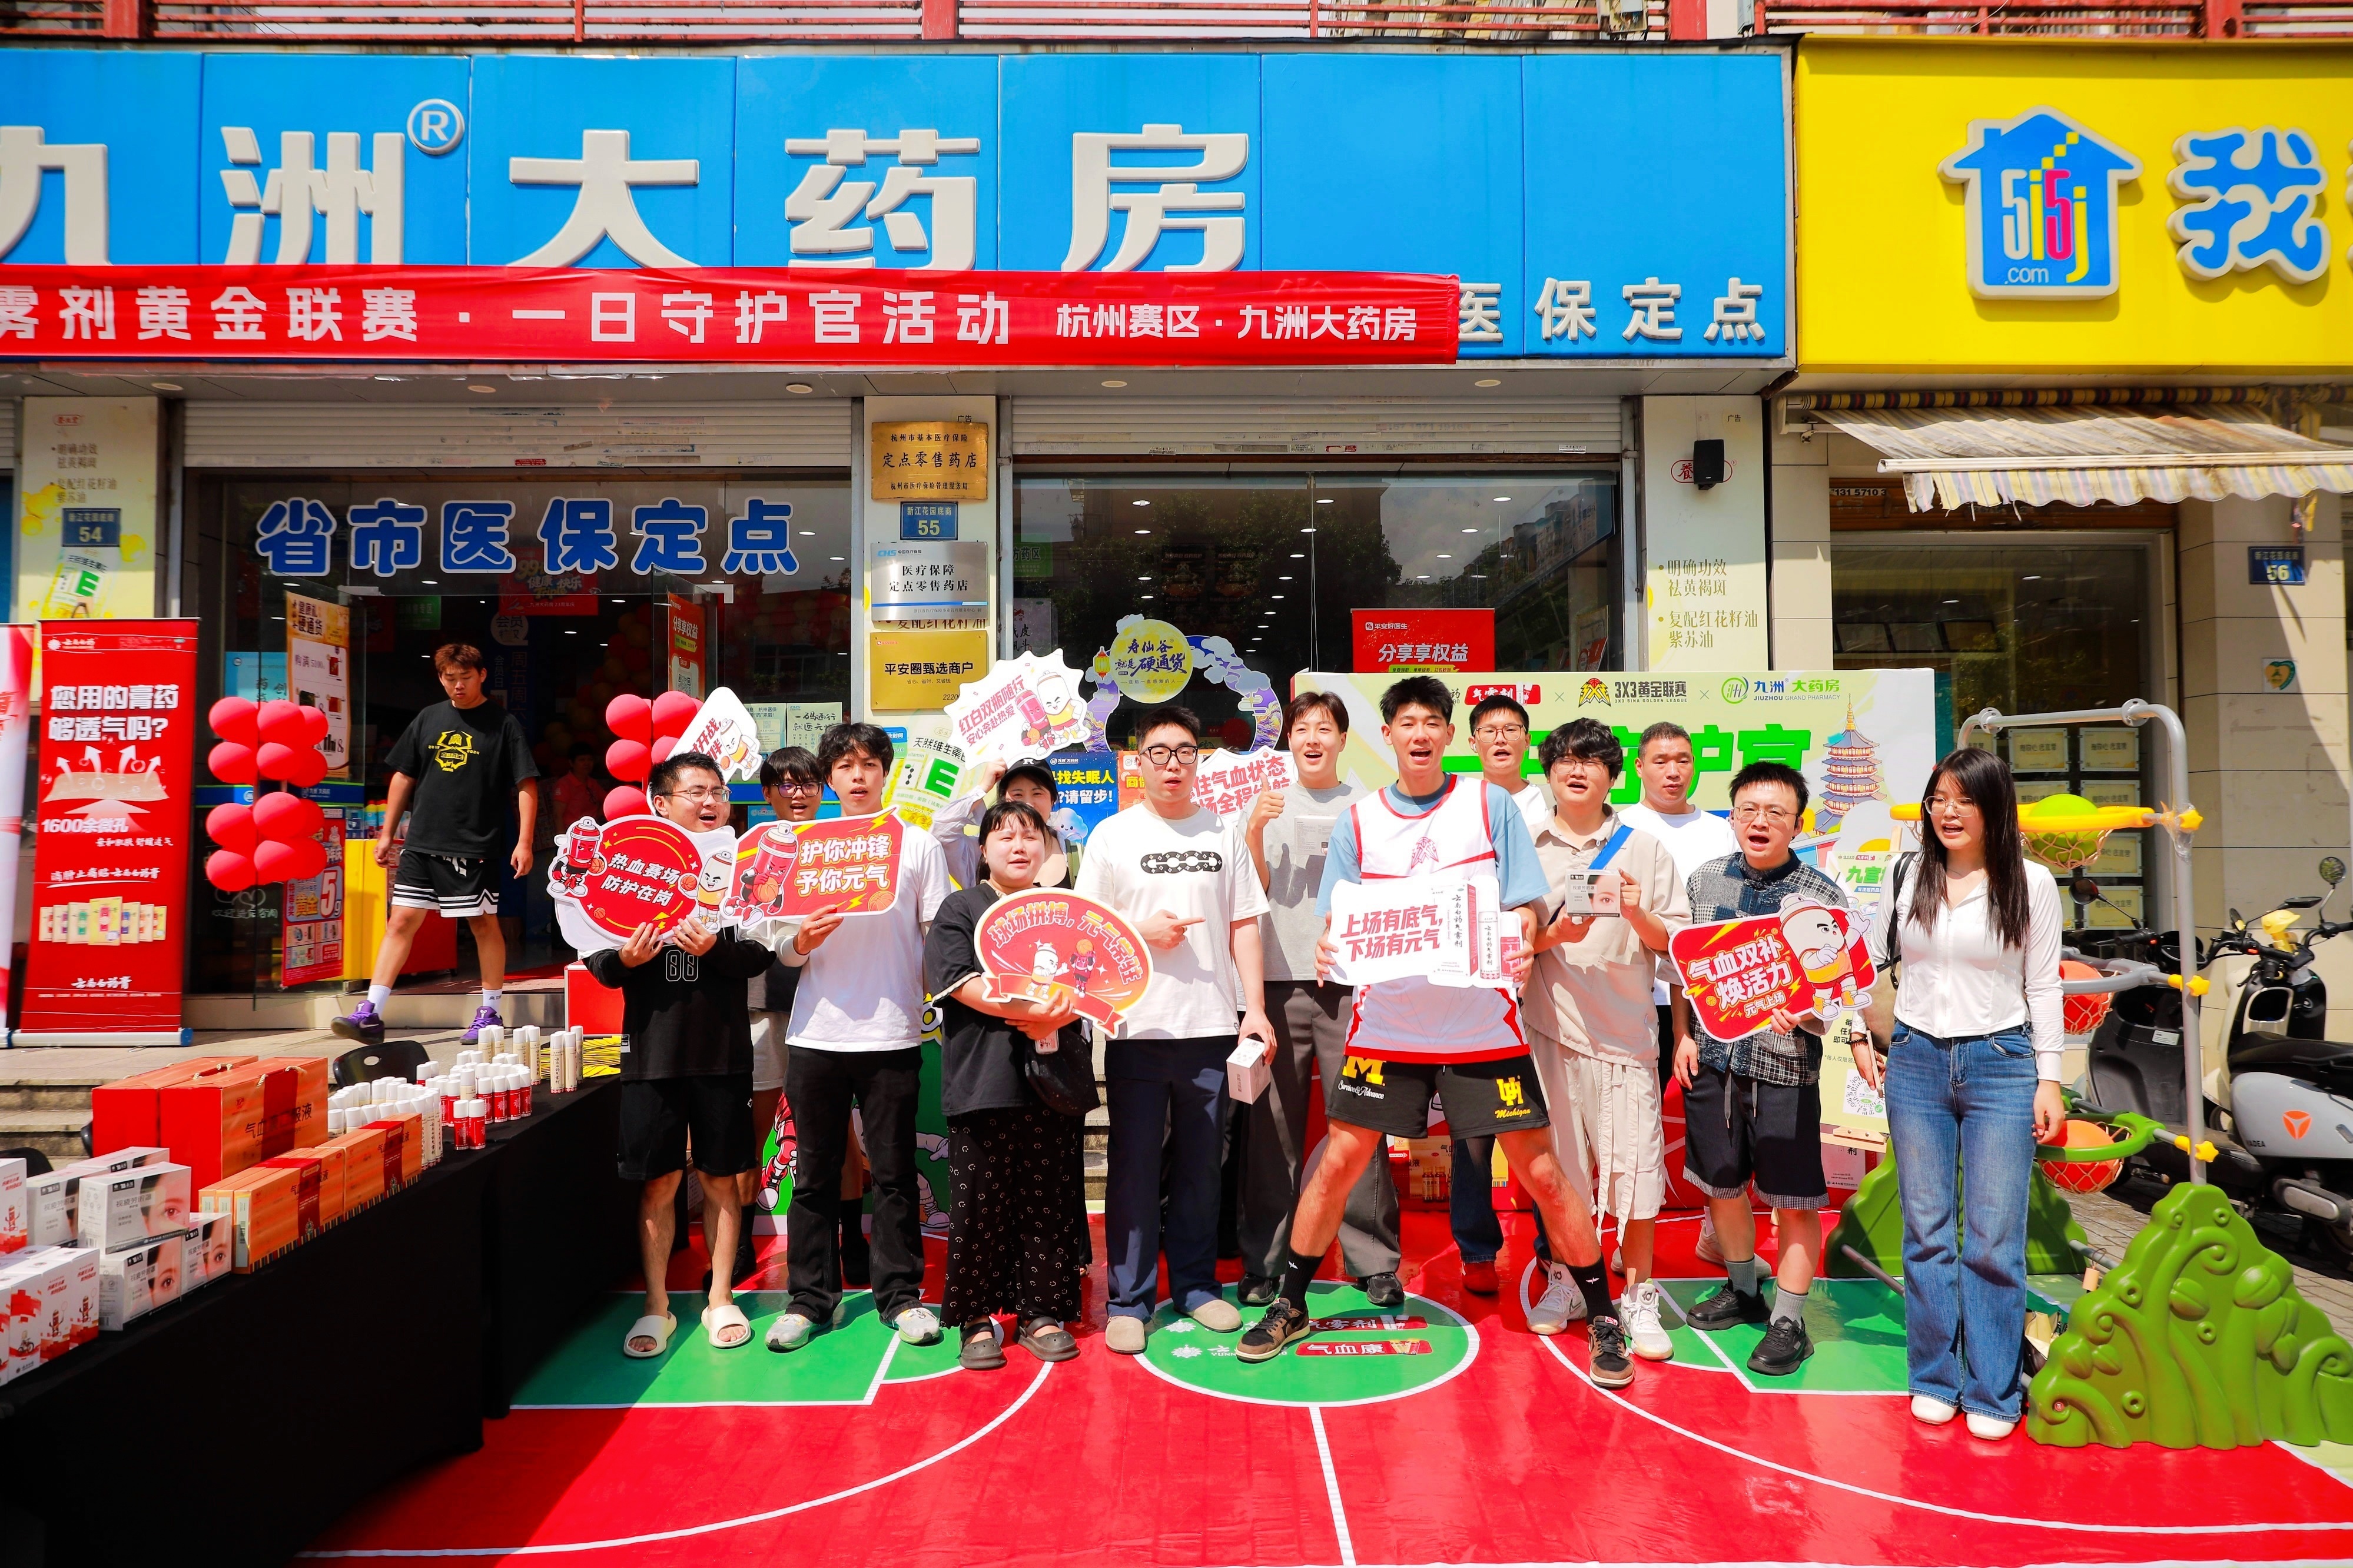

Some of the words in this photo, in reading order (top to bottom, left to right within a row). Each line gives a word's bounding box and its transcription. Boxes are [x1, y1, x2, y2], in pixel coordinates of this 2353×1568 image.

[2002, 168, 2088, 283] 5i5j
[2005, 266, 2049, 285] .com
[1458, 276, 1766, 343] 医保定点
[1056, 303, 1418, 343] 杭州赛区·九洲大药房
[957, 414, 972, 423] 广告
[1727, 414, 1741, 422] 广告
[890, 433, 968, 443] 杭州市基本医疗保险
[882, 451, 978, 469] 定点零售药店
[890, 481, 968, 491] 杭州市医疗保险管理服务局
[907, 506, 953, 516] 新江花园底商
[79, 526, 103, 543] 54
[255, 496, 800, 577] 省市医保定点
[917, 520, 941, 536] 55
[902, 563, 955, 576] 医疗保障
[1667, 559, 1727, 577] 明确功效
[2266, 564, 2290, 581] 56
[889, 579, 968, 592] 定点零售药店
[1667, 579, 1728, 597] 祛黄褐斑
[1669, 609, 1758, 629] 复配红花籽油
[1127, 638, 1174, 655] 寿仙谷
[1668, 630, 1713, 649] 紫苏油
[1378, 643, 1469, 663] 分享享权益
[884, 662, 974, 675] 平安圈甄选商户
[1615, 680, 1688, 698] 3X3黄金联赛
[1753, 679, 1785, 693] 九洲
[1791, 679, 1840, 693] 大药房
[49, 683, 180, 710] 您用的膏药
[942, 693, 960, 702] 2220
[958, 675, 1025, 736] 红白双瓶随行
[48, 715, 169, 742] 够透气吗?
[966, 703, 1016, 748] 安心奔赴热爱
[924, 758, 960, 798] E
[1053, 770, 1115, 786] 找失眠人
[1190, 754, 1286, 798] 住气血状态
[800, 834, 891, 866] 护你冲锋
[608, 852, 681, 885] 热血赛场
[796, 863, 891, 896] 予你元气
[600, 873, 674, 906] 防护在岗
[1346, 928, 1441, 962] 下场有元气
[1687, 934, 1784, 984] 气血双补
[1715, 960, 1793, 1010] 焕活力
[1744, 992, 1786, 1019] 元气上场
[1342, 1055, 1387, 1087] M
[1494, 1107, 1531, 1119] Michigan
[115, 1194, 152, 1209] 视疲劳眼罩
[1306, 1344, 1385, 1355] 气血康
